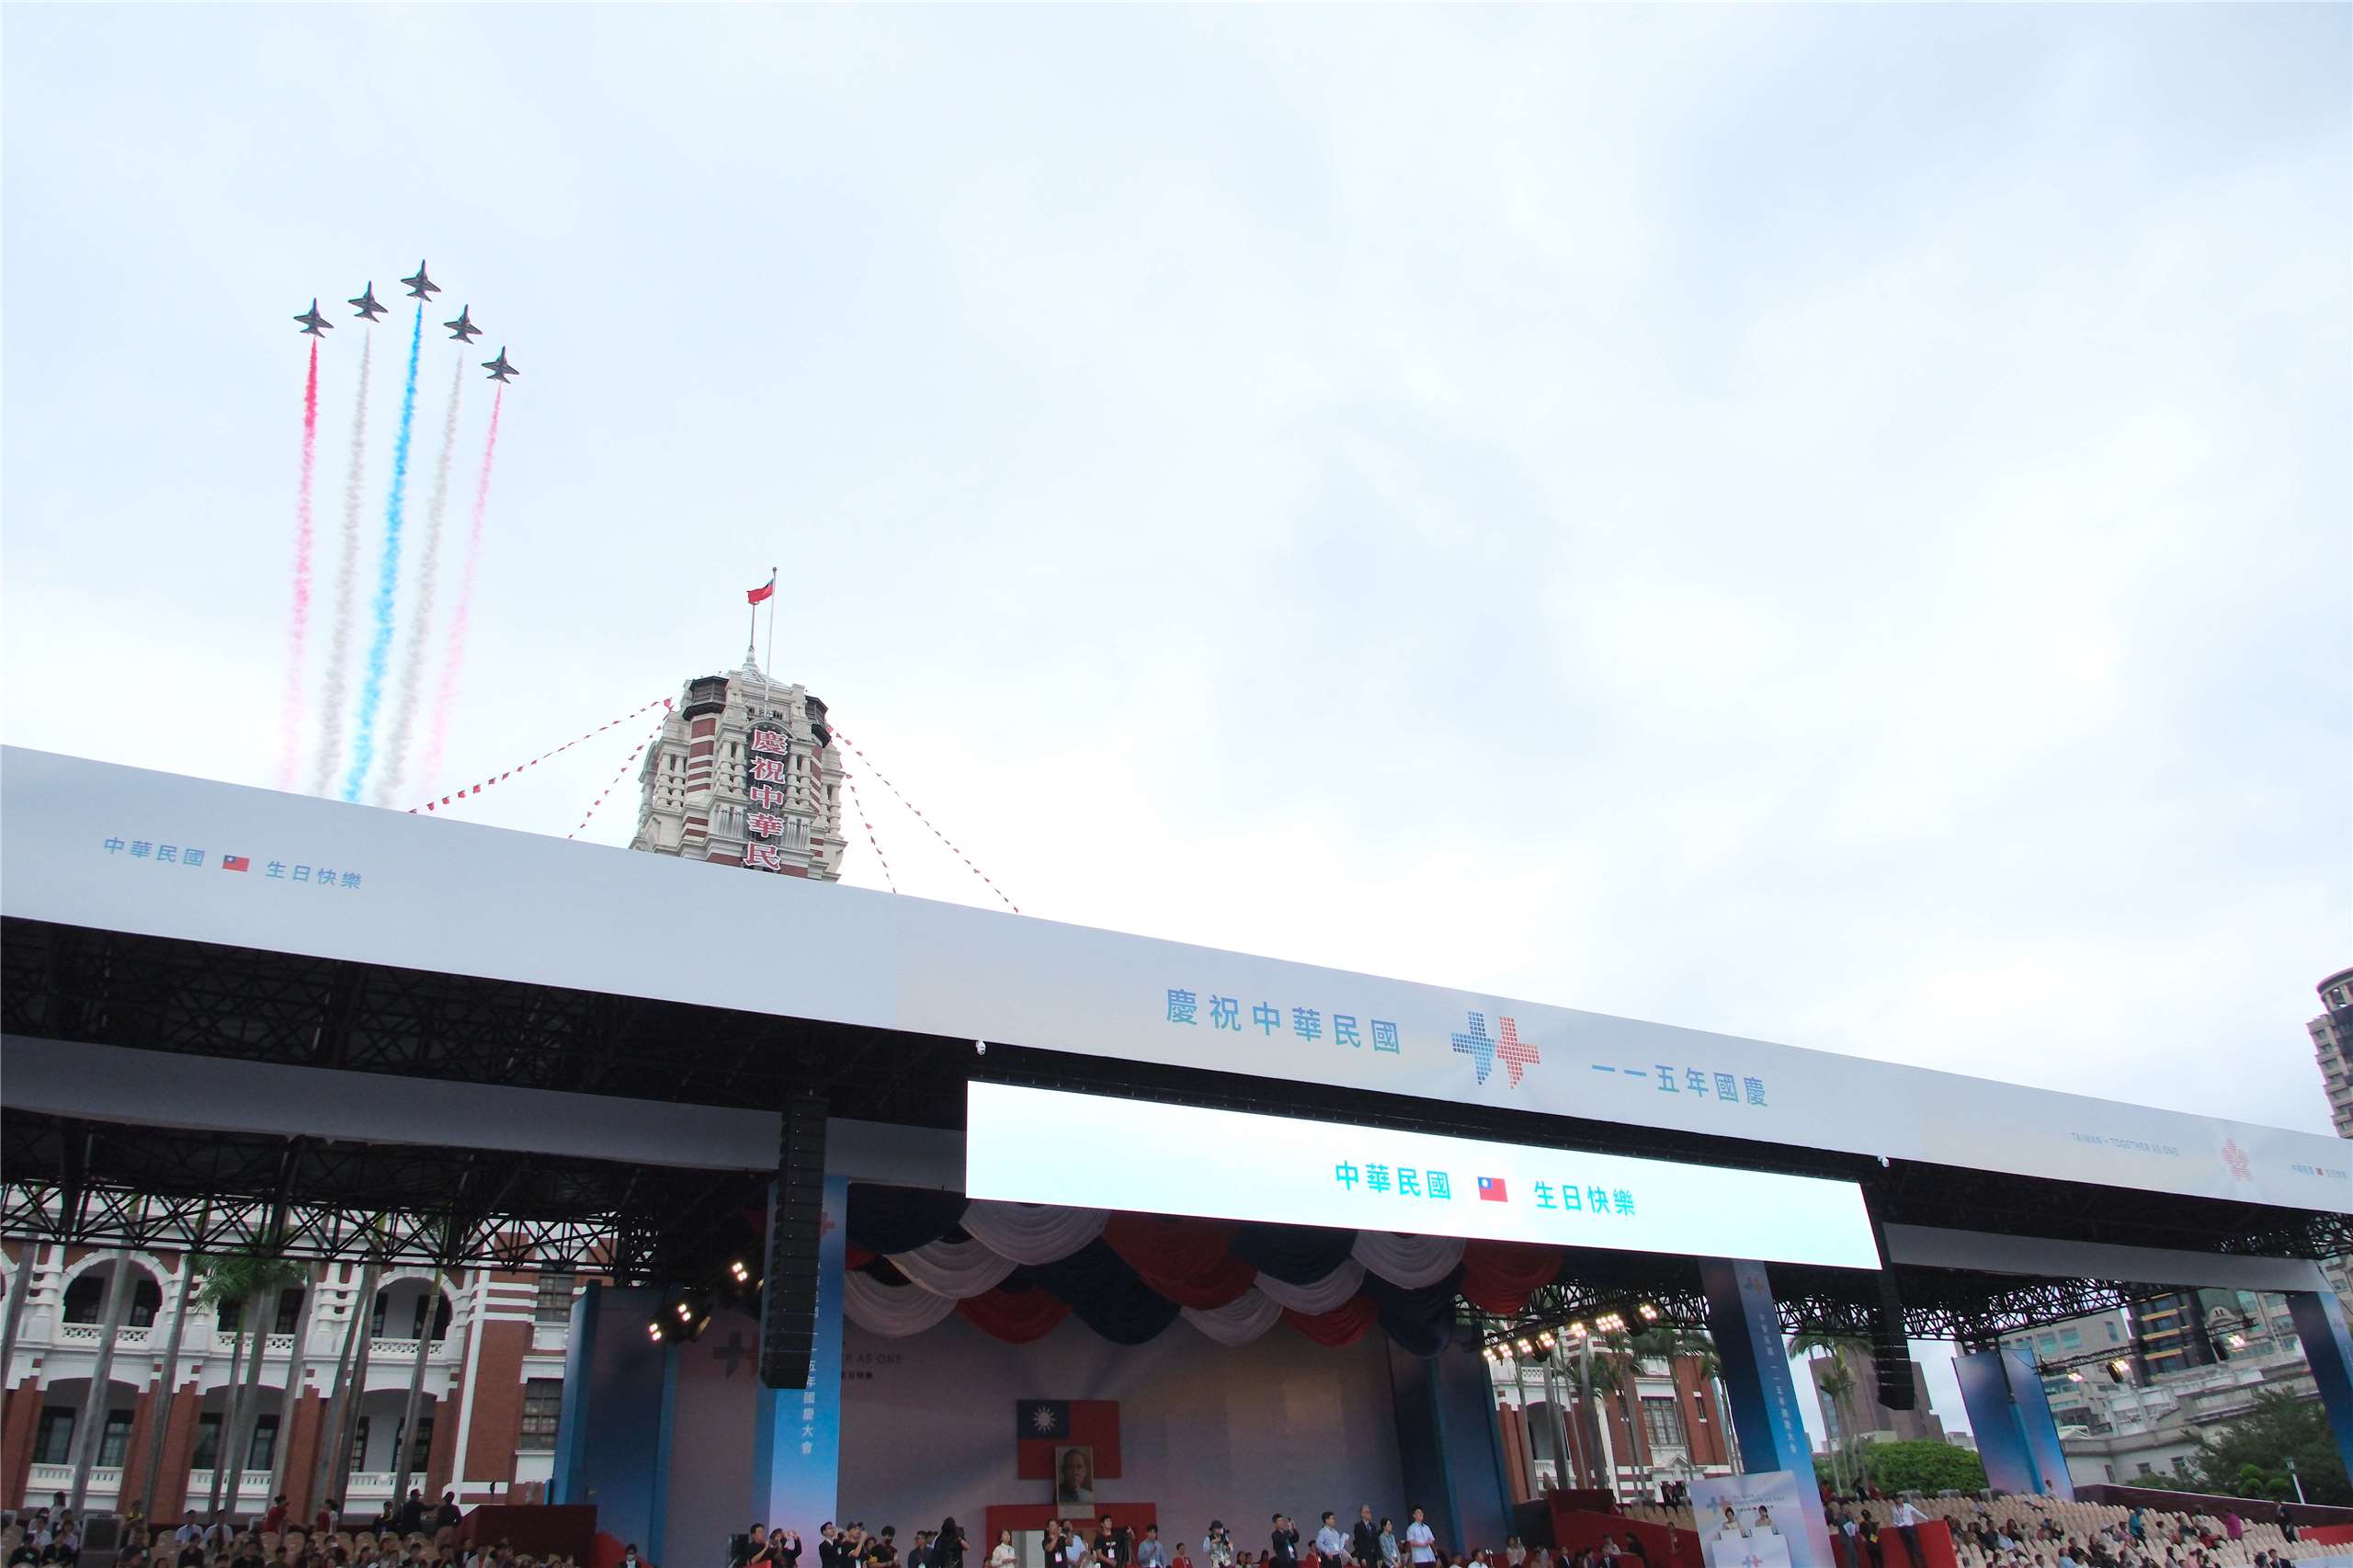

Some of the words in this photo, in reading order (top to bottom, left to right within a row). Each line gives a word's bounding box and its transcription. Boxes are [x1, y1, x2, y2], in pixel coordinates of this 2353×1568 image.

[743, 729, 789, 871] 慶祝中華民
[102, 836, 206, 867] 中華民國
[265, 860, 362, 890] 生日快樂
[1165, 988, 1402, 1055] 慶祝中華民國
[1590, 1062, 1768, 1108] 一一五年國慶
[1335, 1160, 1452, 1200] 中華民國
[1533, 1180, 1636, 1217] 生日快樂
